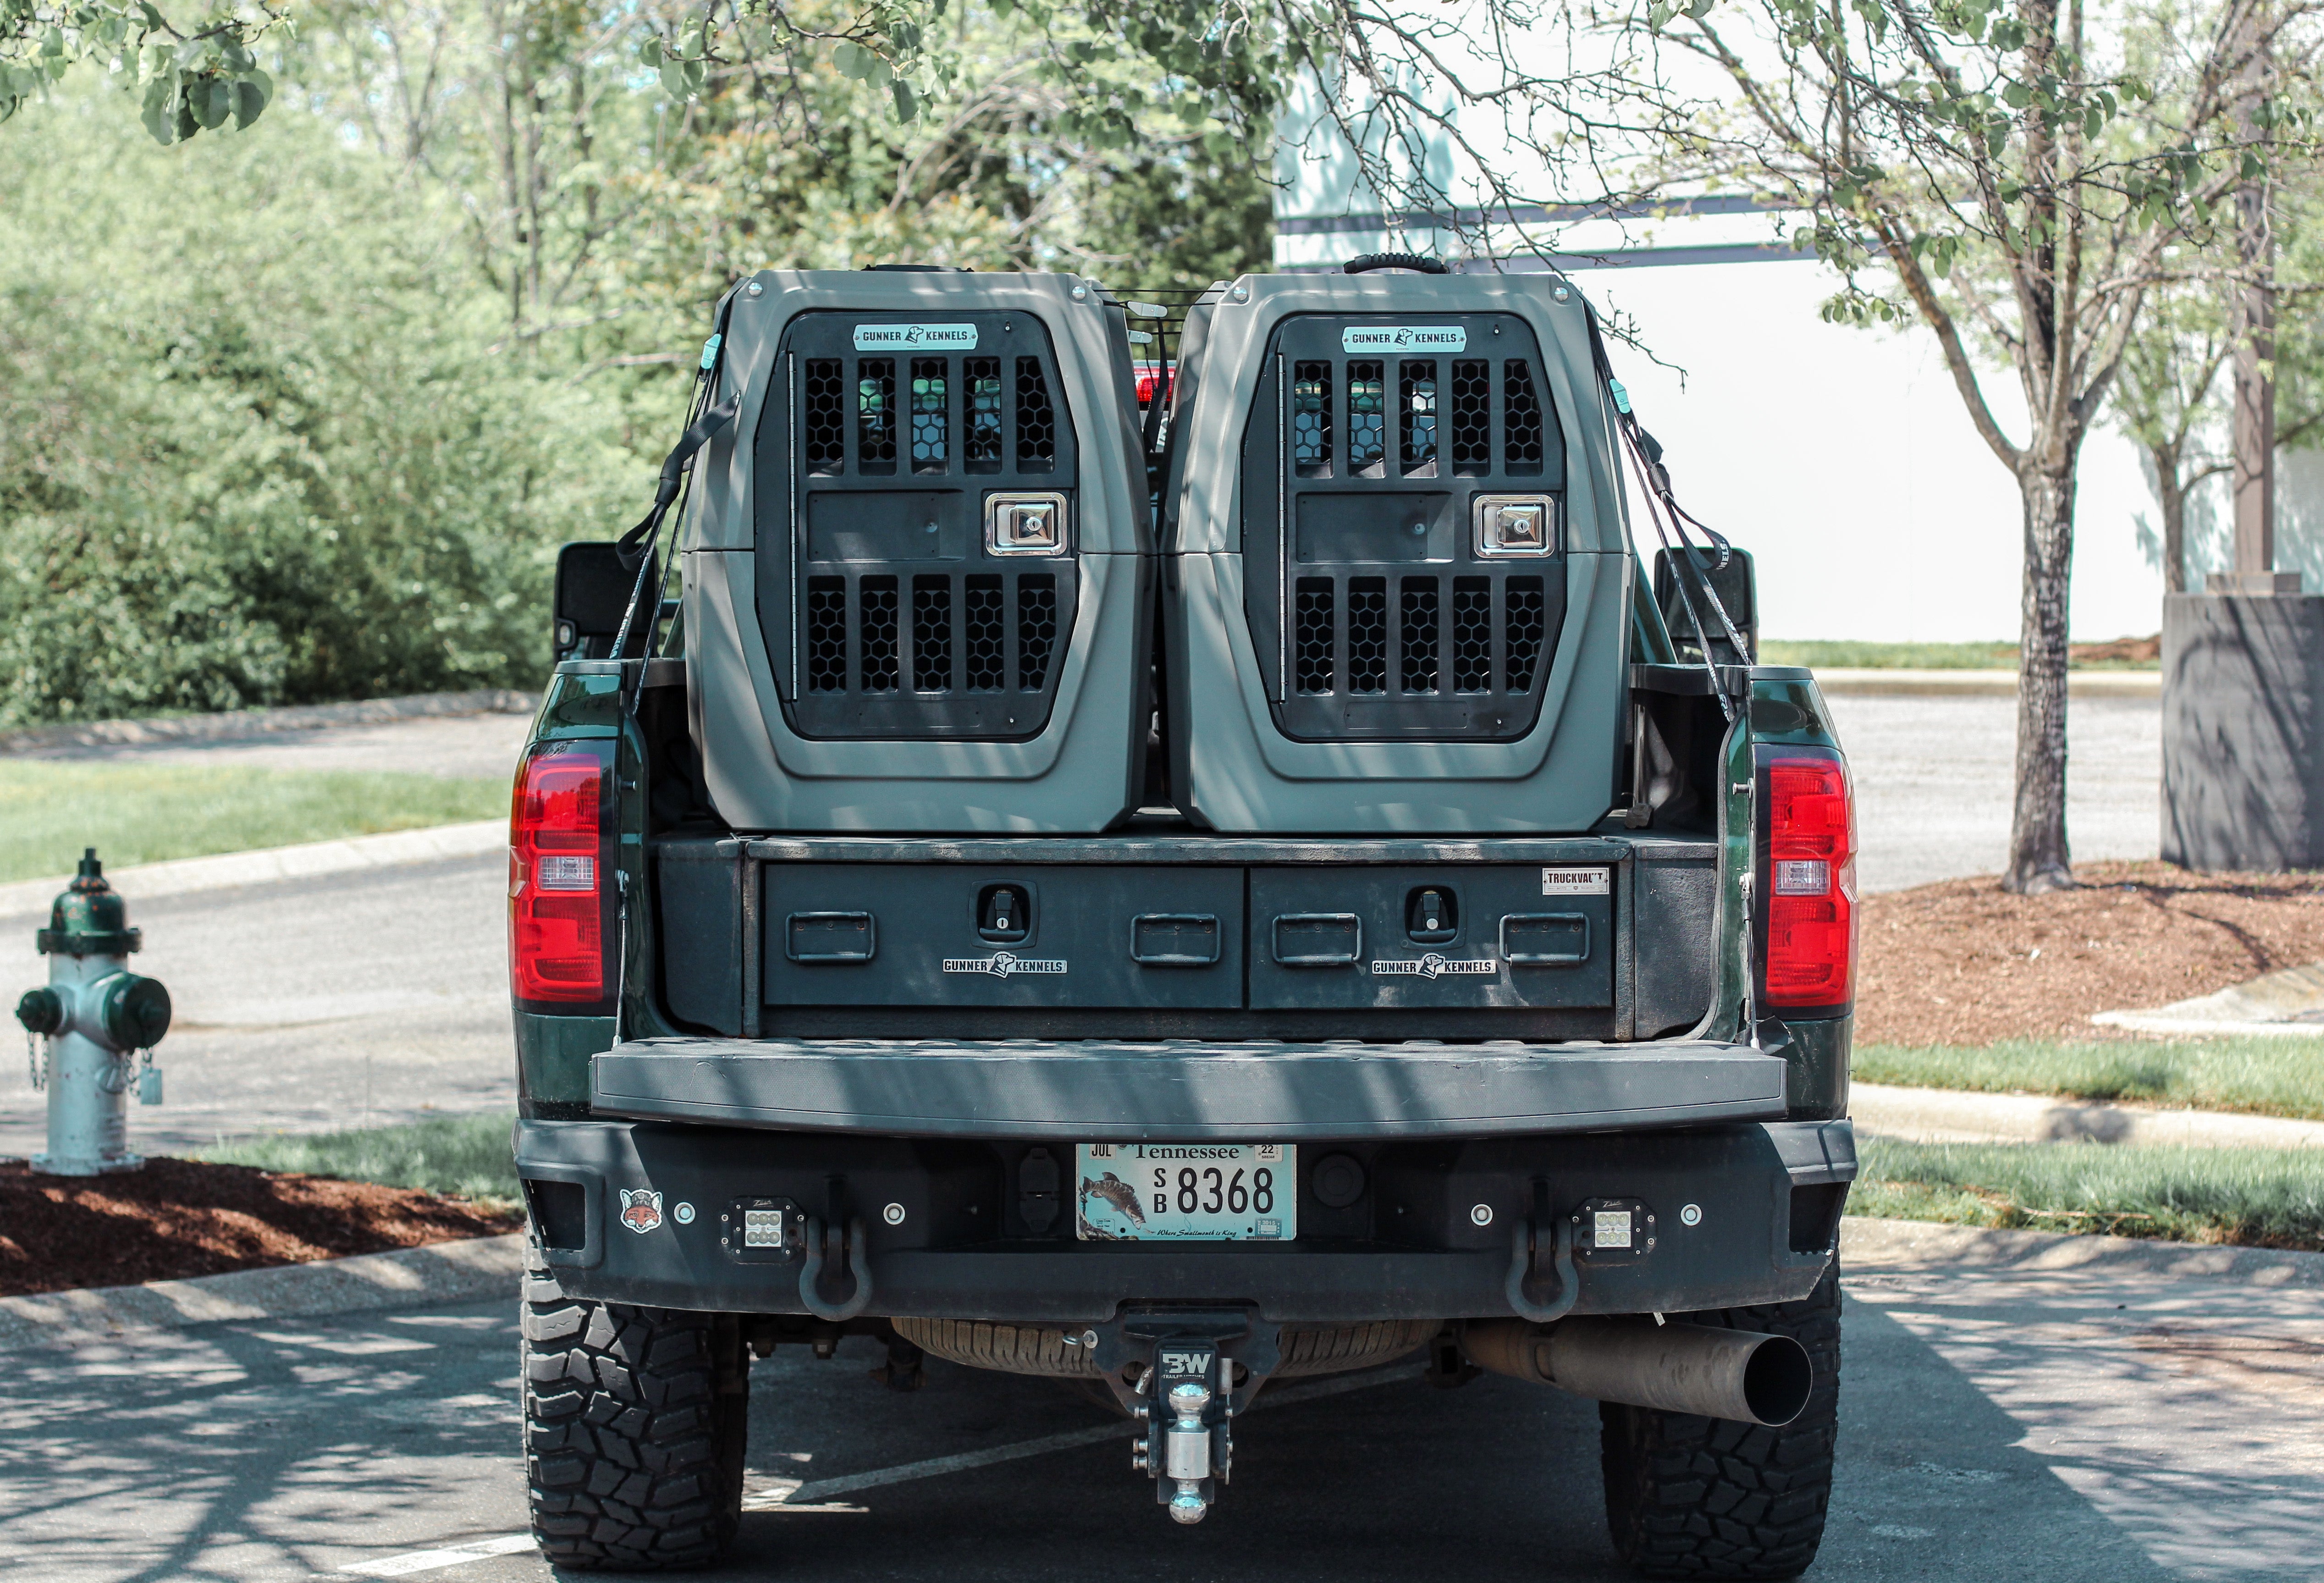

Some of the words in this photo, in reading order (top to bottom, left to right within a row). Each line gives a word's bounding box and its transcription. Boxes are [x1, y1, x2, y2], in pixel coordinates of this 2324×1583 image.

[863, 332, 902, 341] GUNNER
[925, 331, 968, 340] KENNELS
[1352, 333, 1390, 343] GUNNER
[1415, 333, 1456, 343] KENNELS
[944, 961, 987, 971] GUNNER
[1015, 961, 1062, 972] KENNELS
[1374, 962, 1416, 972] GUNNER
[1444, 962, 1491, 972] KENNELS
[1092, 1144, 1111, 1157] JUL
[1132, 1145, 1240, 1159] Tennessee
[1261, 1145, 1274, 1153] 22
[1177, 1167, 1274, 1214] 8368
